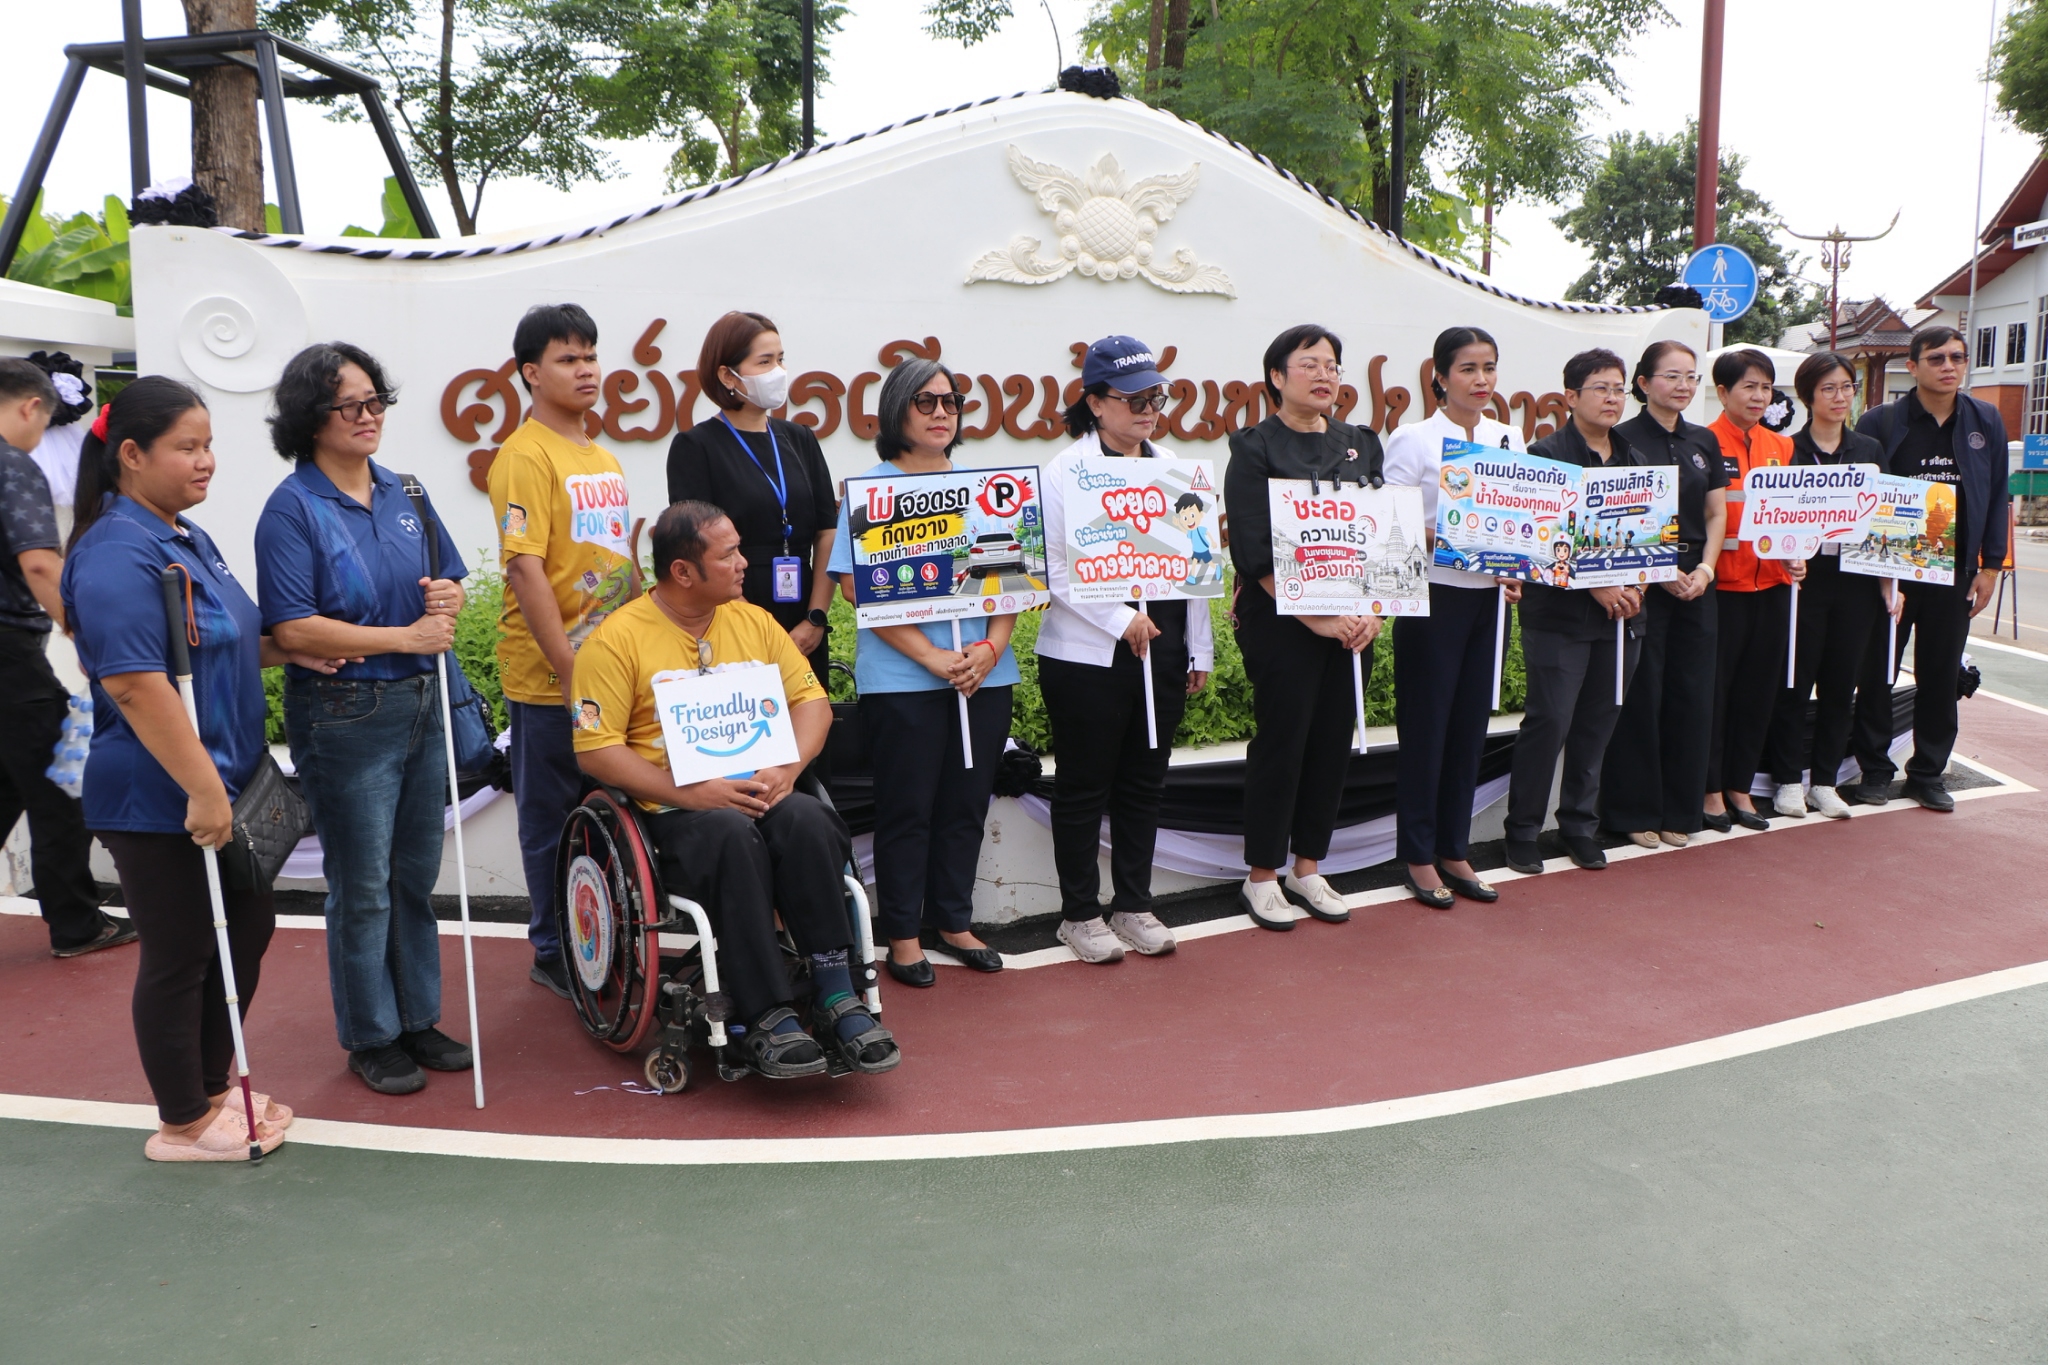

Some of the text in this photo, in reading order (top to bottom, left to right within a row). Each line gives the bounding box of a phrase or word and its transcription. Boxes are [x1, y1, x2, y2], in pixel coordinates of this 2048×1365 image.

[1474, 462, 1567, 486] ถนนปลอดภัย
[1586, 470, 1655, 496] เคารพสิทธิ
[1751, 466, 1865, 489] ถนนปลอดภัย
[1475, 482, 1561, 515] น้ำใจของทุกคน
[1512, 484, 1537, 495] เริ่มจาก
[1605, 488, 1653, 506] คนเดินเท้า
[1798, 494, 1827, 505] เริ่มจาก
[866, 486, 970, 521] ไม่ จอดรถ
[1102, 486, 1167, 534] หยุด
[1293, 499, 1356, 521] ชะลอ
[1753, 499, 1857, 529] น้ำใจของทุกคน
[576, 512, 607, 537] FOR
[881, 518, 948, 546] กีดขวาง
[1075, 523, 1127, 547] ให้คนข้าม
[1300, 524, 1367, 545] ความเร็ว
[869, 534, 968, 564] ทางเท้าและทางลาด
[1304, 548, 1347, 560] ในเขตชุมชน
[1075, 541, 1189, 583] ทางม้าลาย
[1300, 557, 1365, 582] เมืองเก่า
[1288, 583, 1299, 592] 30
[906, 605, 933, 619] จอดถูกที่
[669, 691, 757, 726] Friendly
[681, 720, 748, 744] Design
